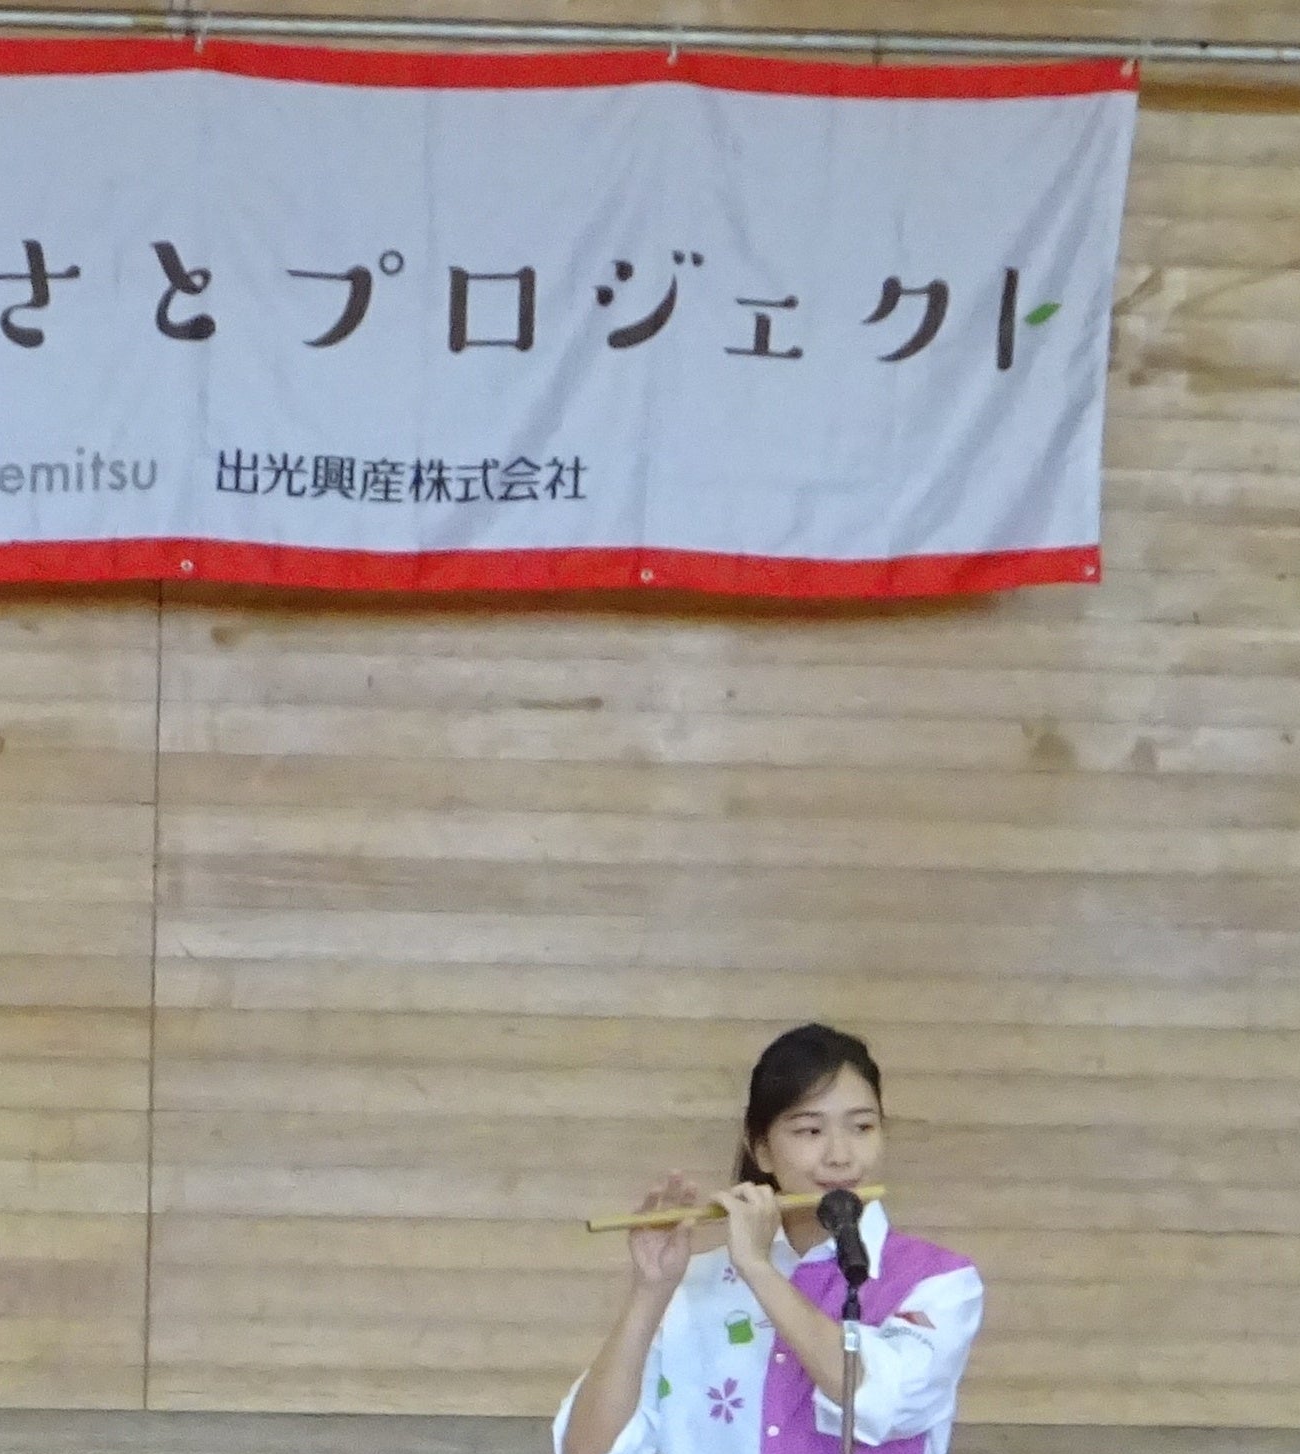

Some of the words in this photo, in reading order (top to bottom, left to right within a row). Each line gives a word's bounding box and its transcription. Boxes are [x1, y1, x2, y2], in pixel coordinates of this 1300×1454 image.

[215, 447, 588, 503] 出光興産株式会社
